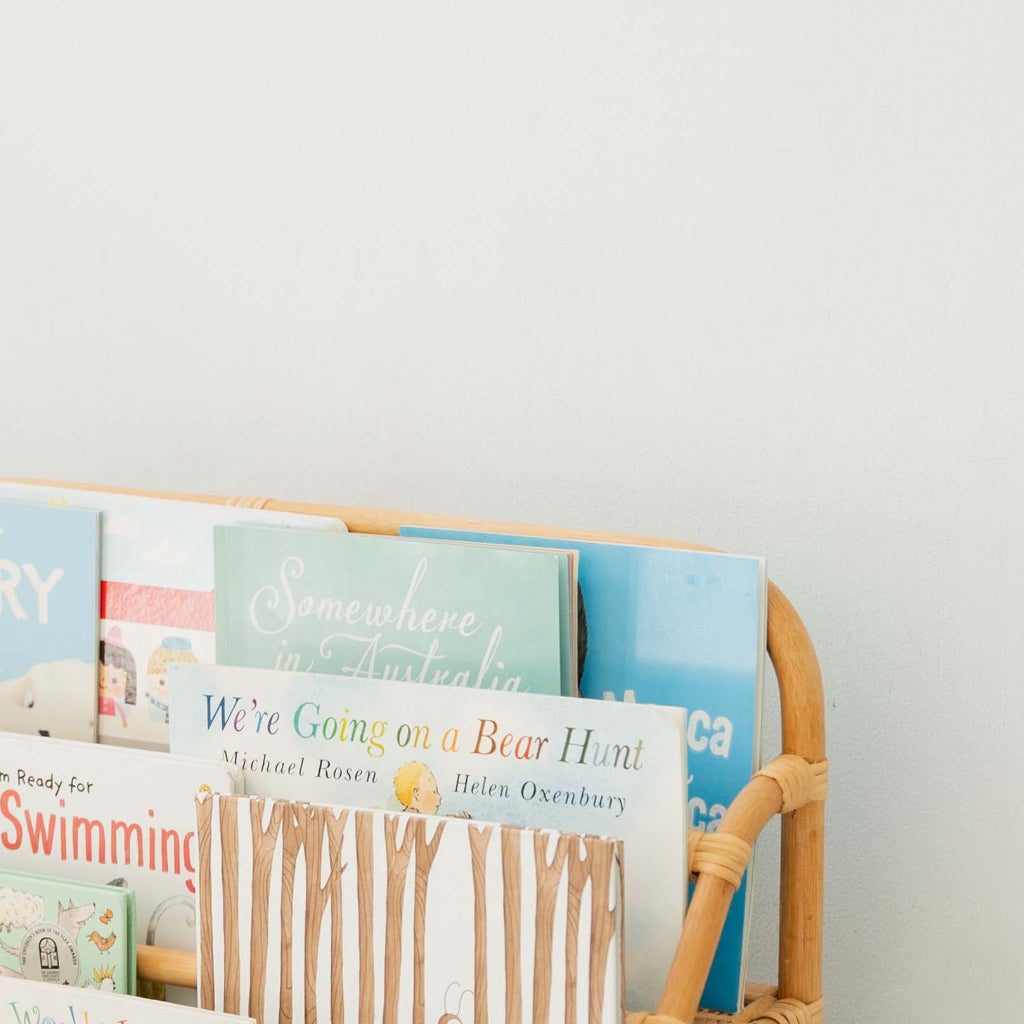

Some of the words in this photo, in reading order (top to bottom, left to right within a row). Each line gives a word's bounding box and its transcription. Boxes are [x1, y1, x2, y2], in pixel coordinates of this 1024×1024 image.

[249, 556, 484, 637] Somewhere
[203, 694, 280, 736] We're
[294, 701, 388, 758] Going
[396, 723, 431, 750] on
[440, 728, 459, 752] a
[471, 718, 549, 760] Bear
[557, 726, 645, 771] Hunt
[17, 769, 63, 796] Ready
[69, 776, 94, 794] for
[222, 750, 305, 776] Michael
[316, 758, 378, 784] Rosen
[453, 773, 510, 798] Helen
[520, 781, 626, 818] Oxenbury
